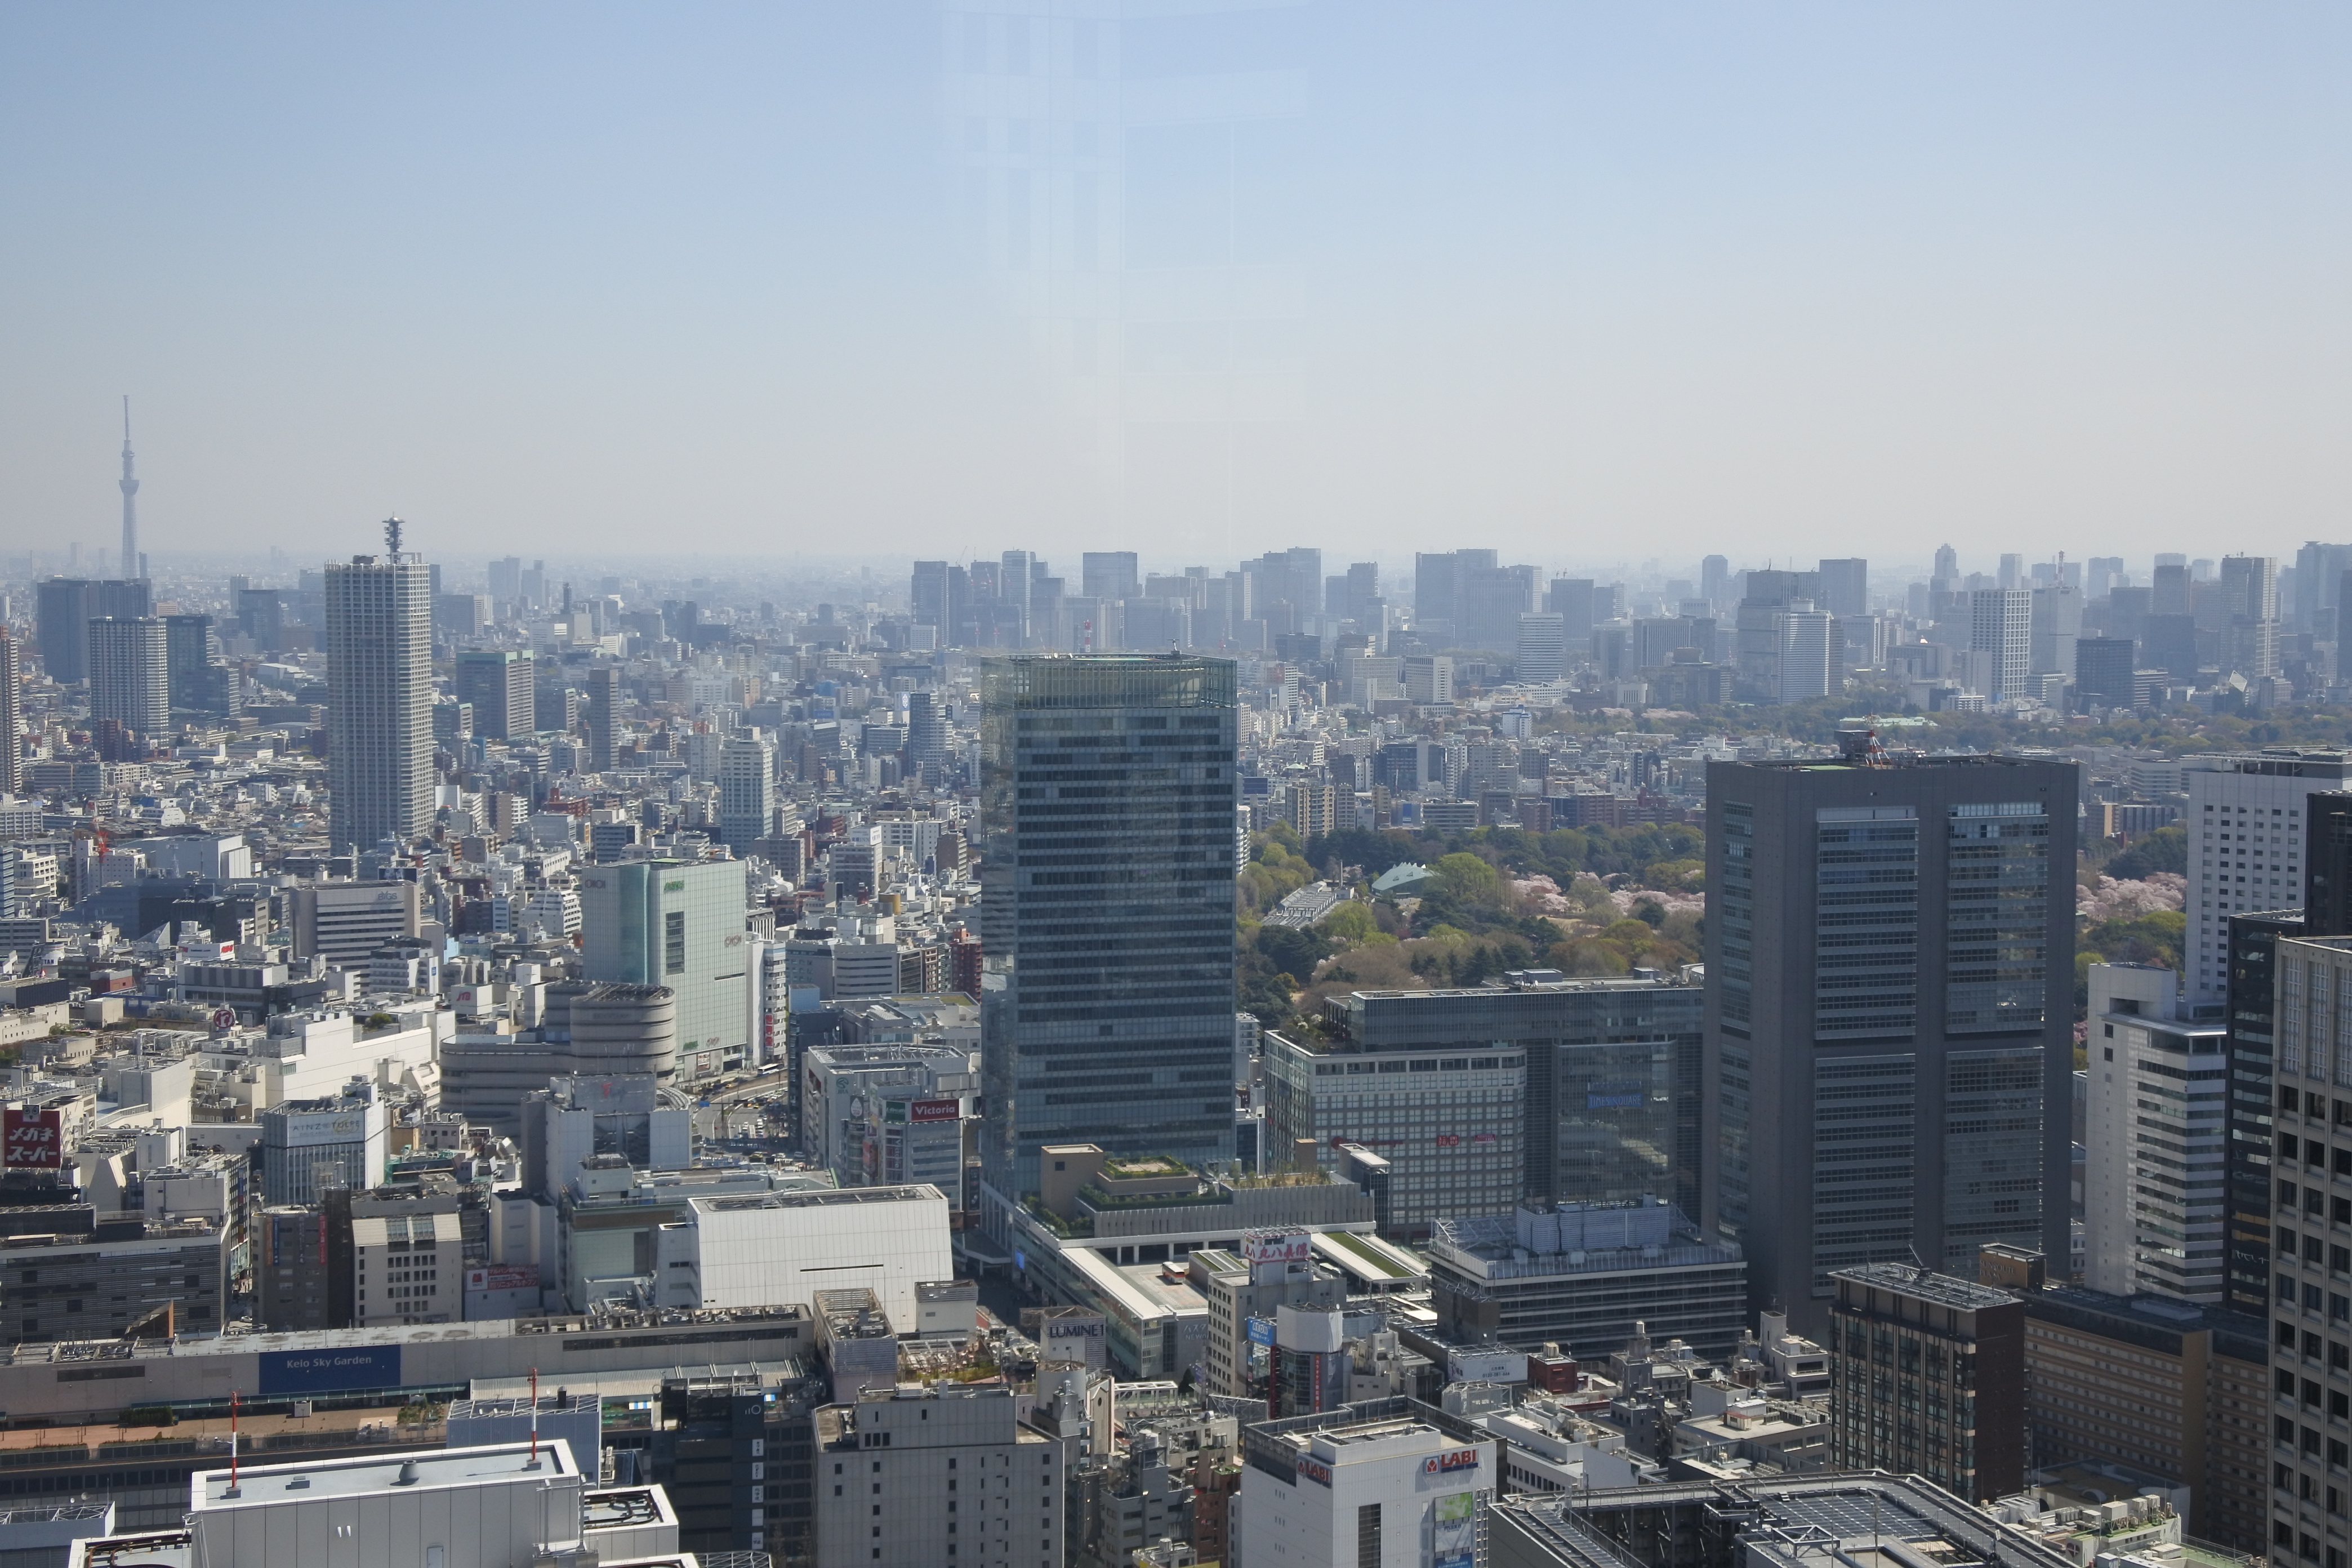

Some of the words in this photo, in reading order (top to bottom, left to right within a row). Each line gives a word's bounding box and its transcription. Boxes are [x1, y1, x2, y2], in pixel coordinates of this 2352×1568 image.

[378, 891, 397, 900] BYGS
[456, 992, 471, 1001] JTB
[915, 1104, 955, 1115] Victoria
[1590, 1096, 1610, 1106] TIMES
[1611, 1096, 1641, 1111] SQUARE
[9, 1127, 54, 1141] メガネ
[7, 1146, 57, 1162] スーパー
[1252, 1322, 1268, 1335] AEON
[287, 1358, 310, 1369] Keio
[313, 1358, 332, 1370] Sky
[335, 1356, 372, 1367] Garden
[1441, 1449, 1477, 1467] LABI
[1307, 1462, 1328, 1482] LABI
